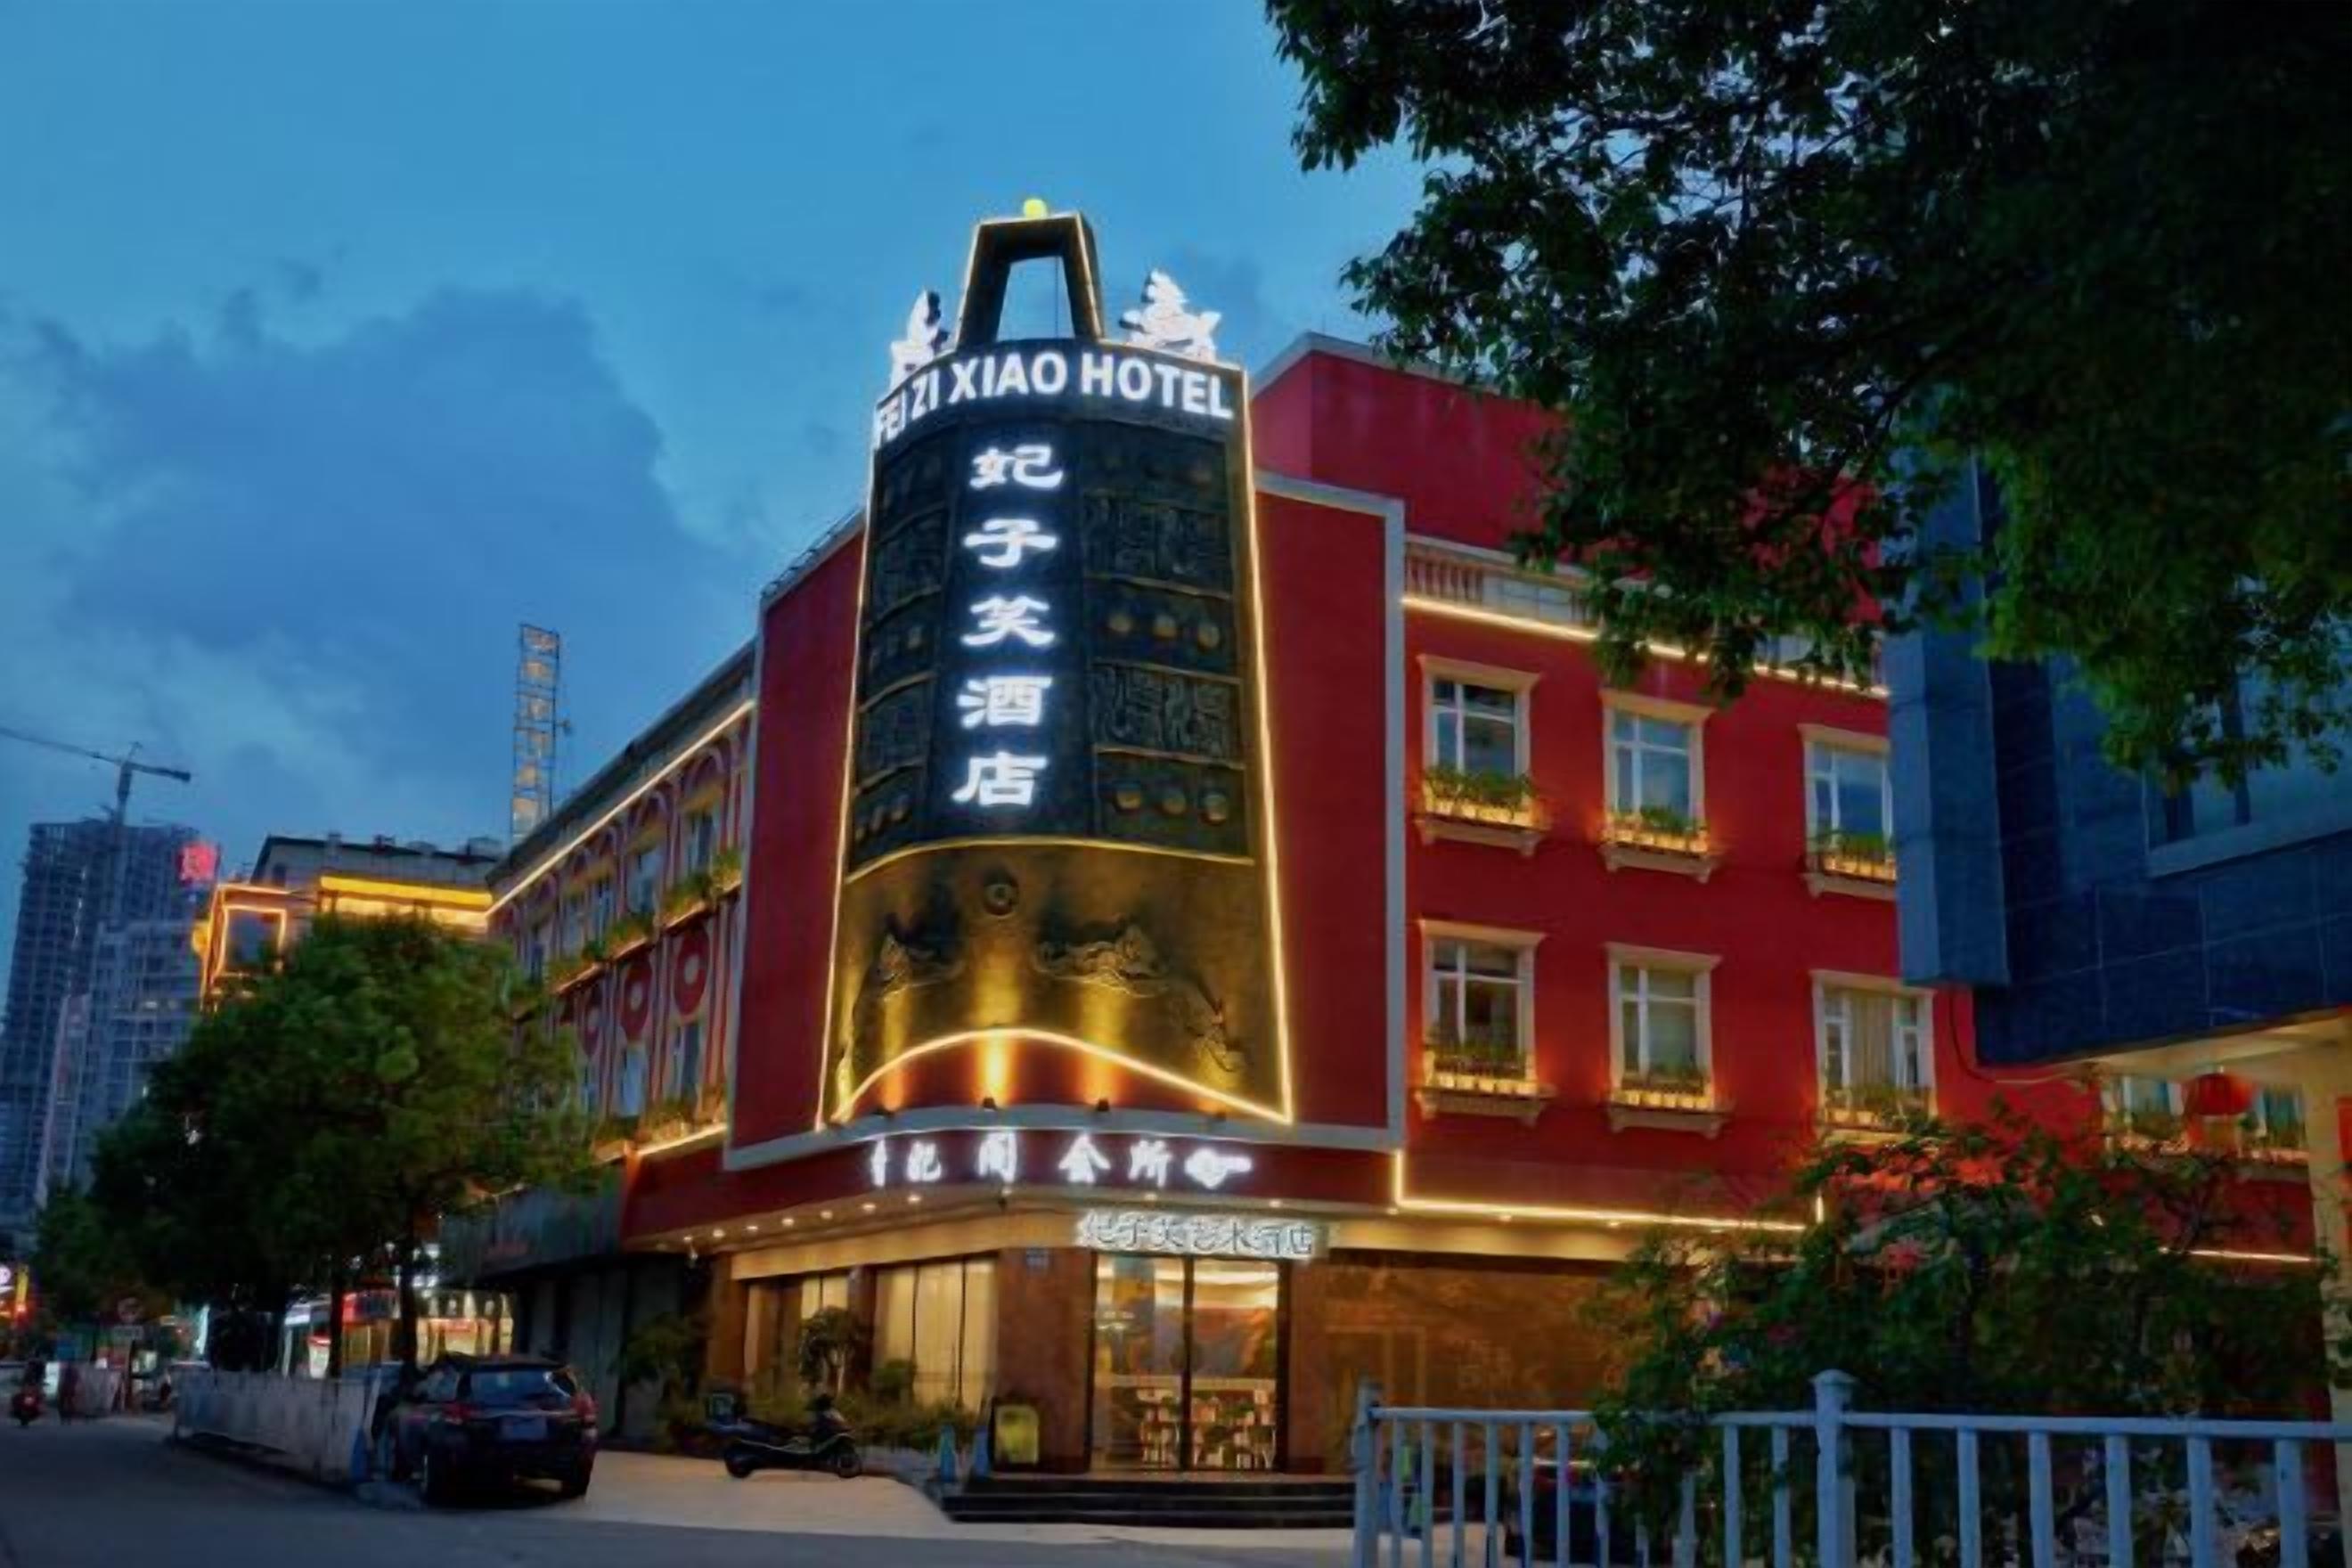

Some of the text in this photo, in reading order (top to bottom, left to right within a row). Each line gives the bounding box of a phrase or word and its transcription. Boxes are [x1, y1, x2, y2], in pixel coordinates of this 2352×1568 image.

[911, 368, 940, 421] ZI
[948, 352, 1067, 404] XIAO
[1081, 353, 1233, 421] HOTEL
[952, 444, 1064, 807] 妃子笑酒店
